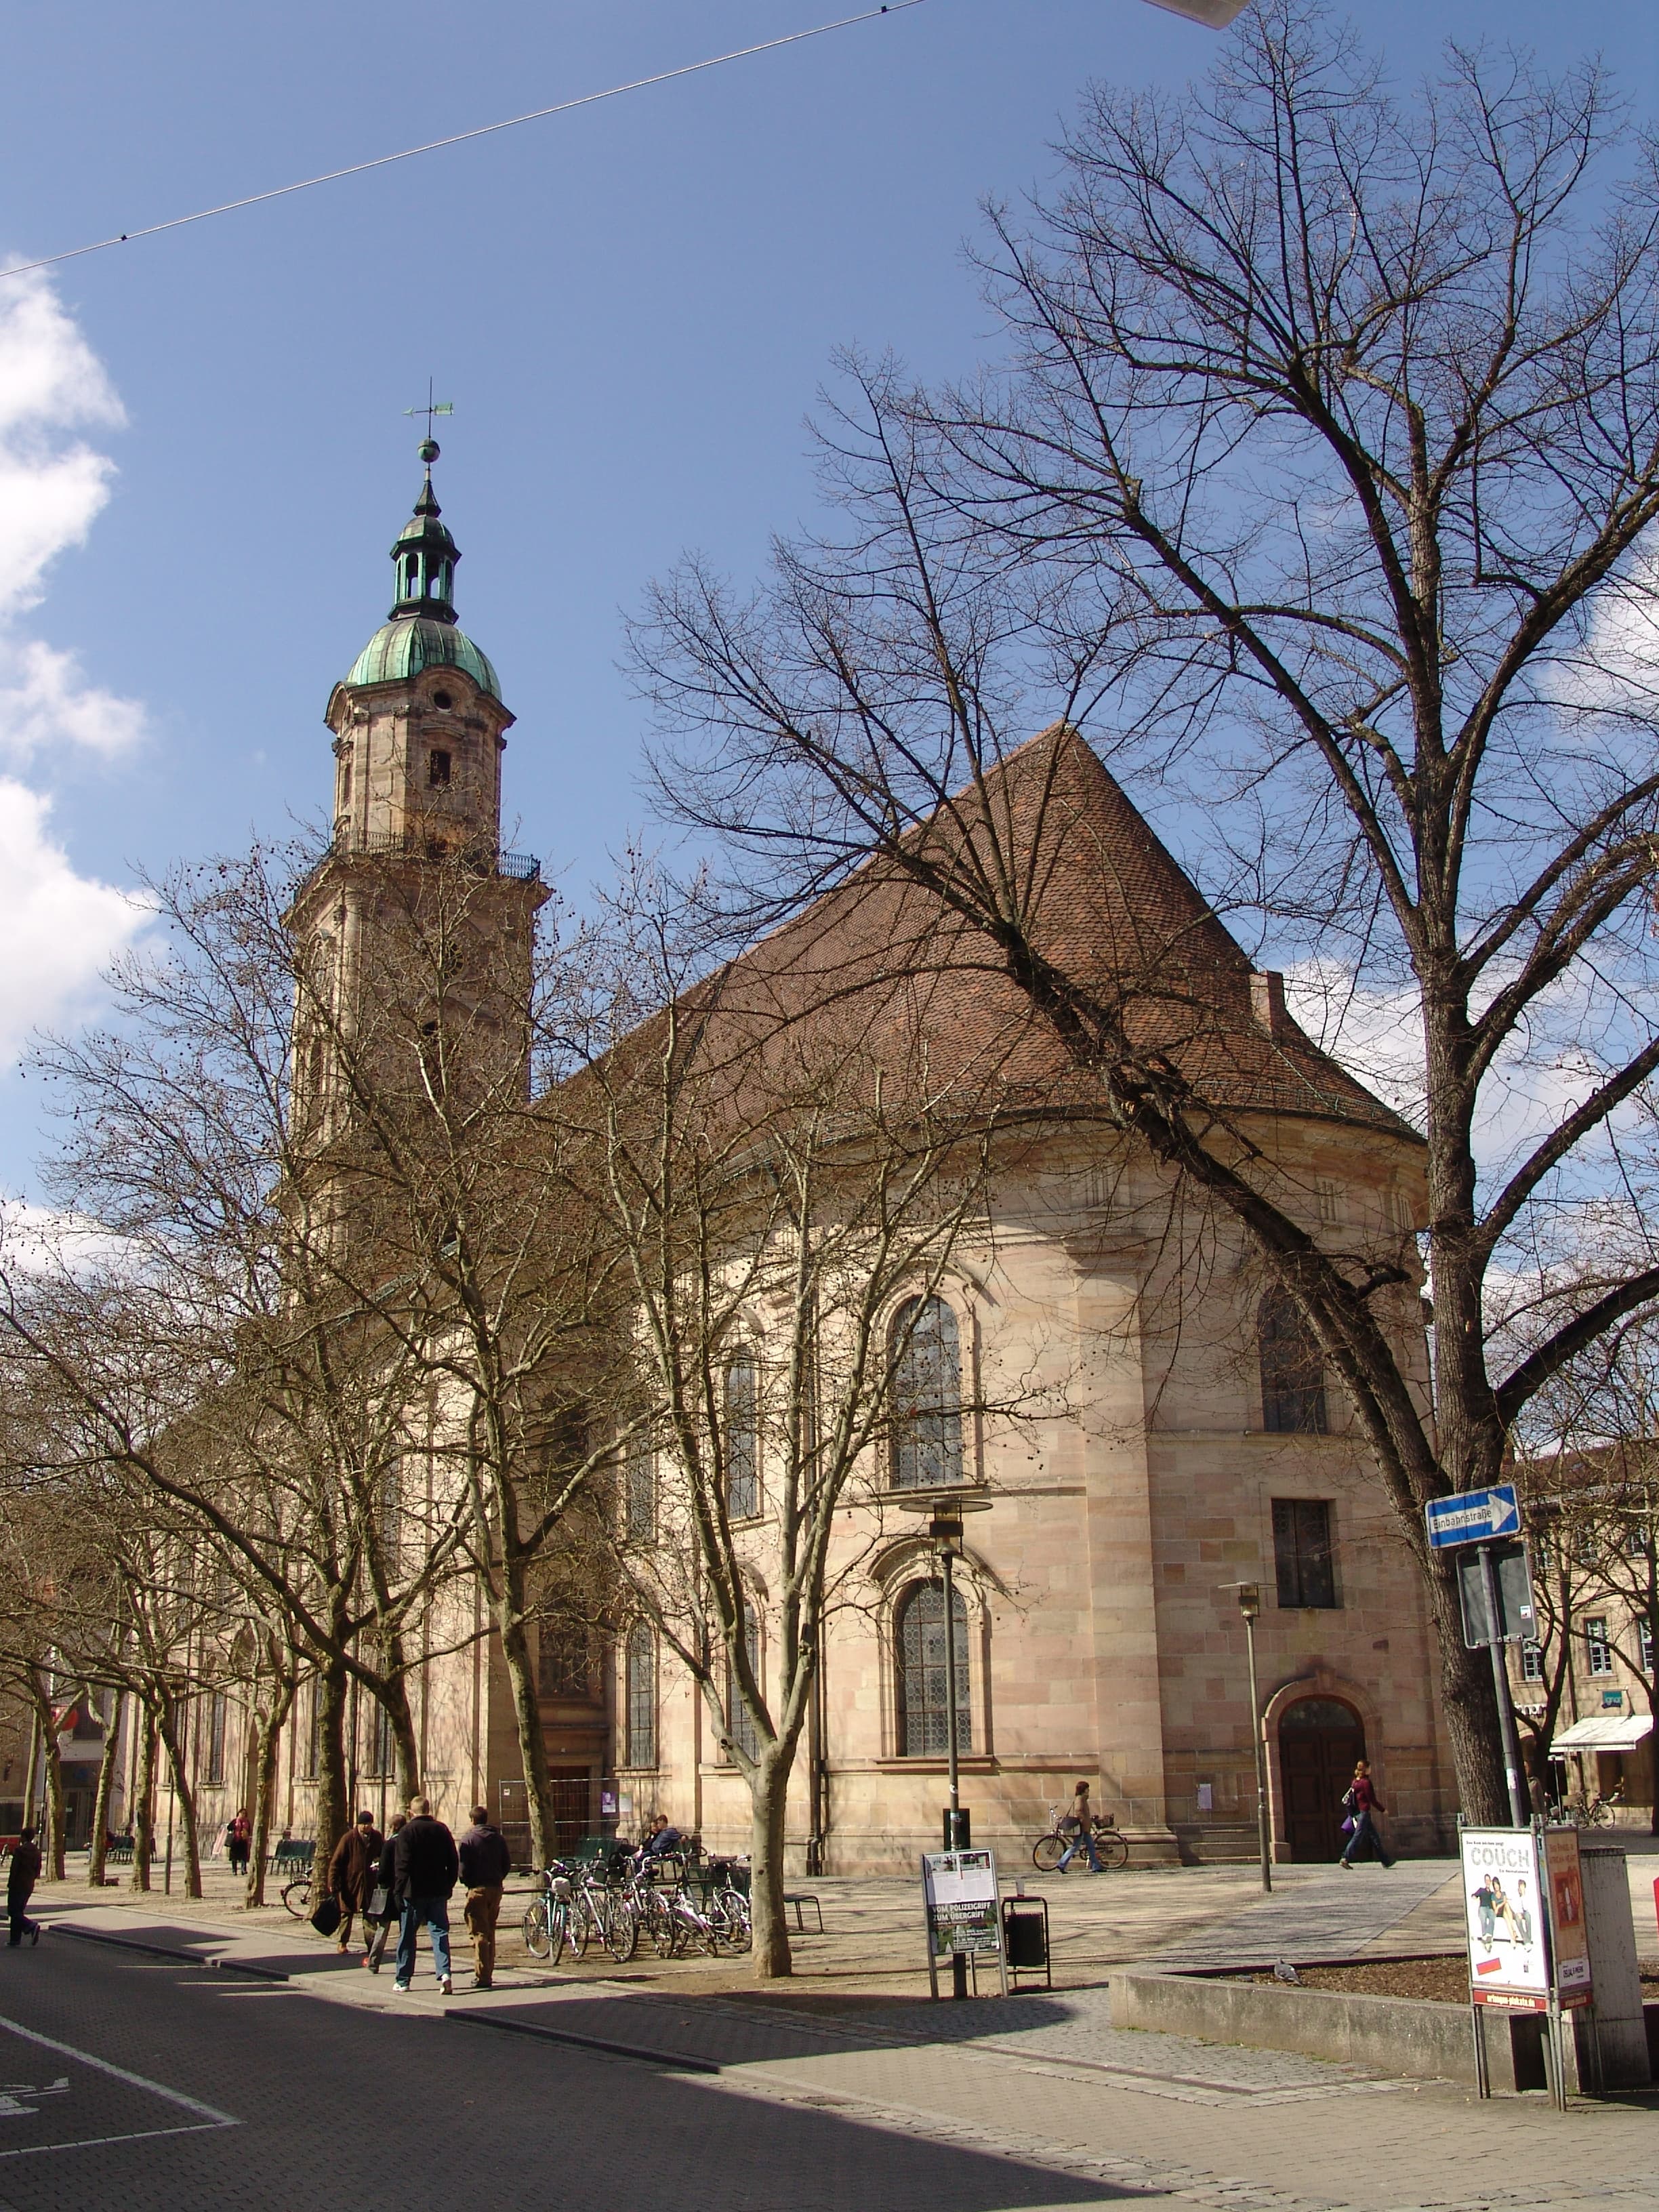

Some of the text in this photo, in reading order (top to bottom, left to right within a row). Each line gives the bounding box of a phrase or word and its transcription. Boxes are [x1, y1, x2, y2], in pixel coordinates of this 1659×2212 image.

[1433, 1509, 1492, 1529] Einbahnstraße
[1471, 1847, 1530, 1868] COUCH
[933, 1902, 991, 1912] VOM POLIZEIGRIFF
[933, 1910, 985, 1921] ZUM ÜBERGRIFF
